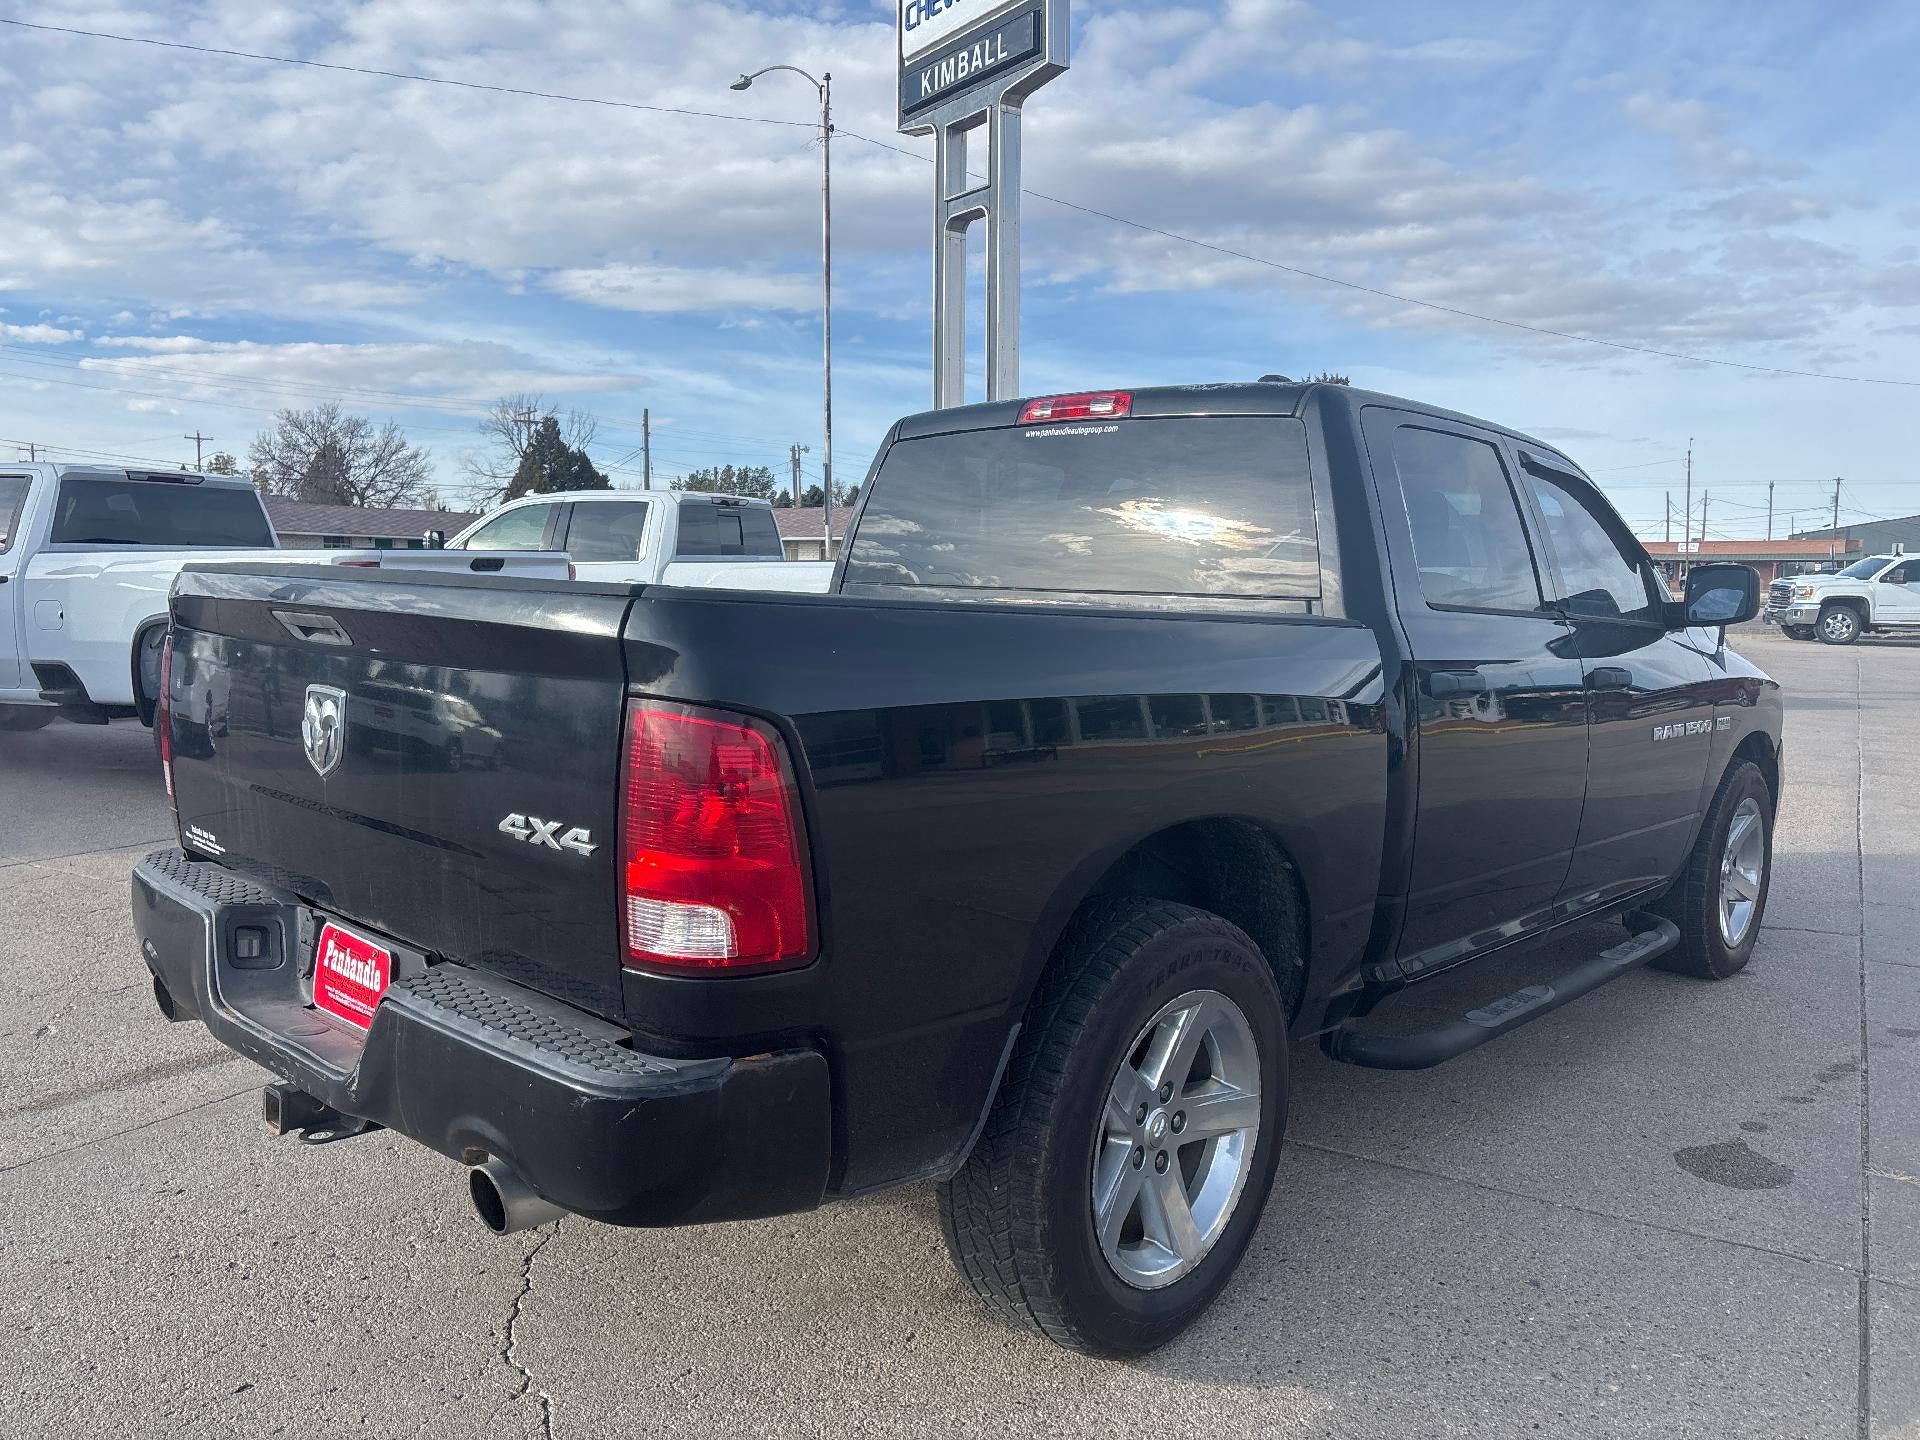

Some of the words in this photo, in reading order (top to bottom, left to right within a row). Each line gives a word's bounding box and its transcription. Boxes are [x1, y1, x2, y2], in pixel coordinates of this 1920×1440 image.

[905, 0, 953, 31] CHE
[921, 33, 1008, 97] KIMBALL
[1653, 726, 1684, 741] RAM
[1685, 719, 1712, 736] 1500
[323, 939, 381, 993] Panhandle
